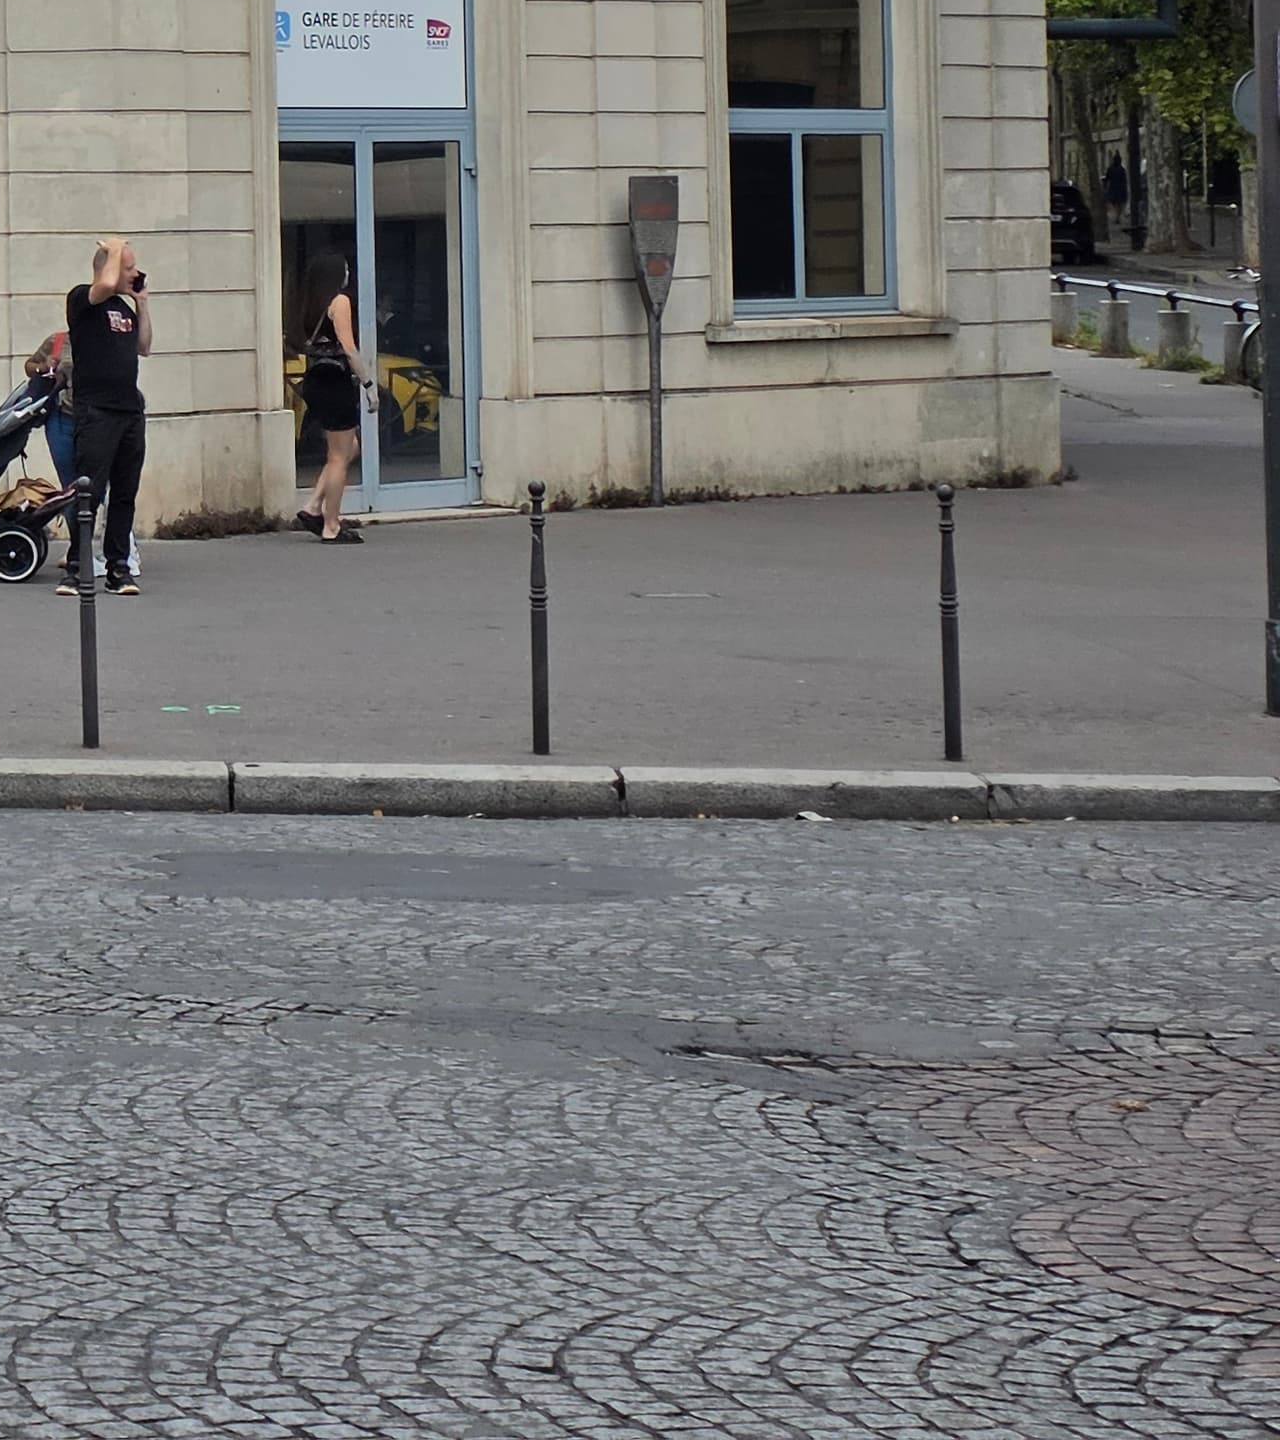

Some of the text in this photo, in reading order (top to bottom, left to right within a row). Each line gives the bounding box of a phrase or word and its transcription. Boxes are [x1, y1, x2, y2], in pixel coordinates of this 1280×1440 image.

[302, 9, 415, 28] GARE DE PÉREIRE
[303, 34, 370, 49] LEVALLOIS
